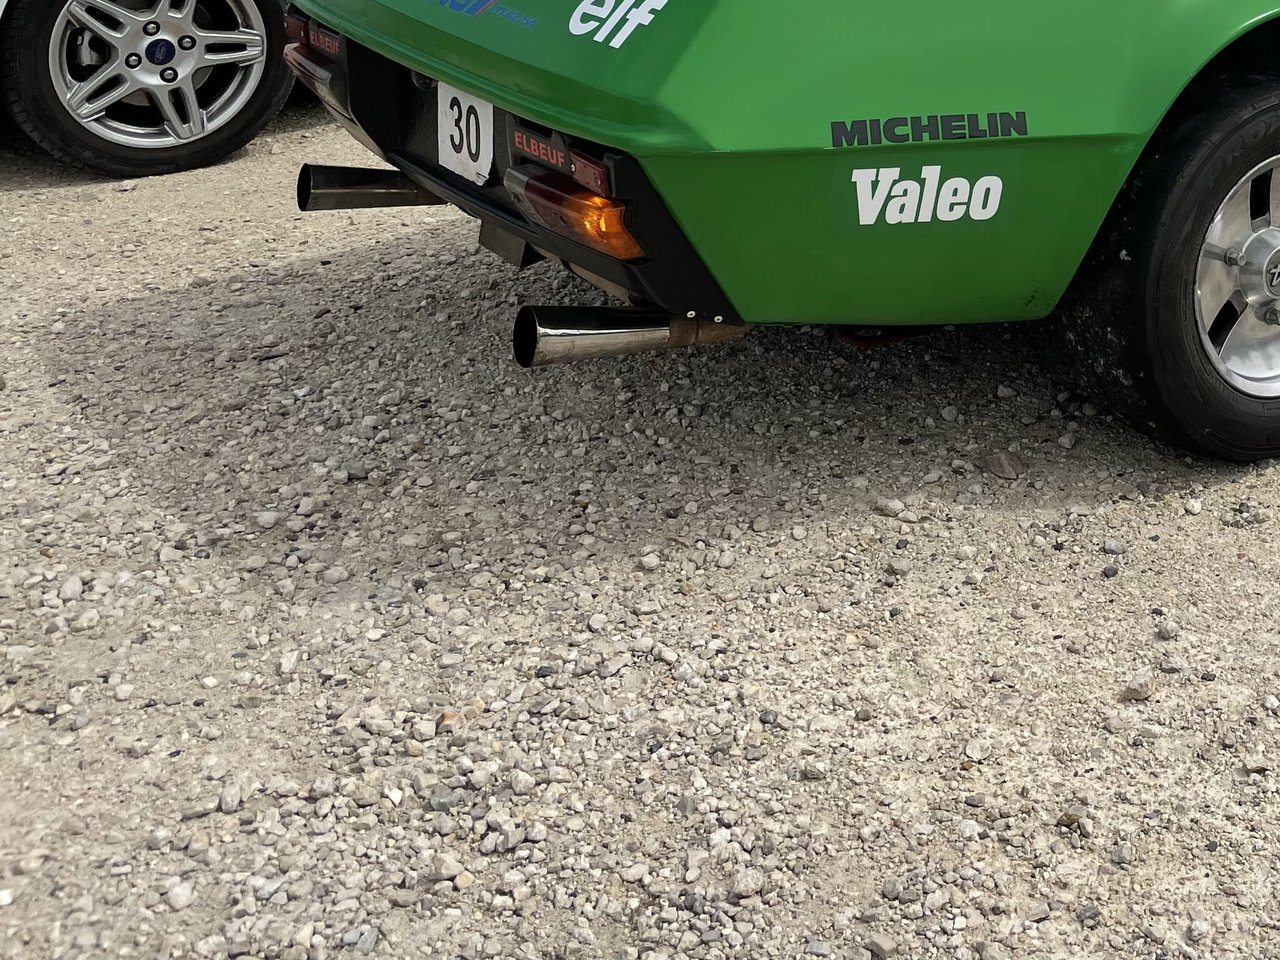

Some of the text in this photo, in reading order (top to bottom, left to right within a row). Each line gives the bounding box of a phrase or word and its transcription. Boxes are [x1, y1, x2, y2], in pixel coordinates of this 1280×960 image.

[449, 96, 482, 163] 30
[513, 130, 566, 168] ELBEUF
[830, 111, 1028, 148] MICHELIN
[851, 165, 1003, 226] Valeo
